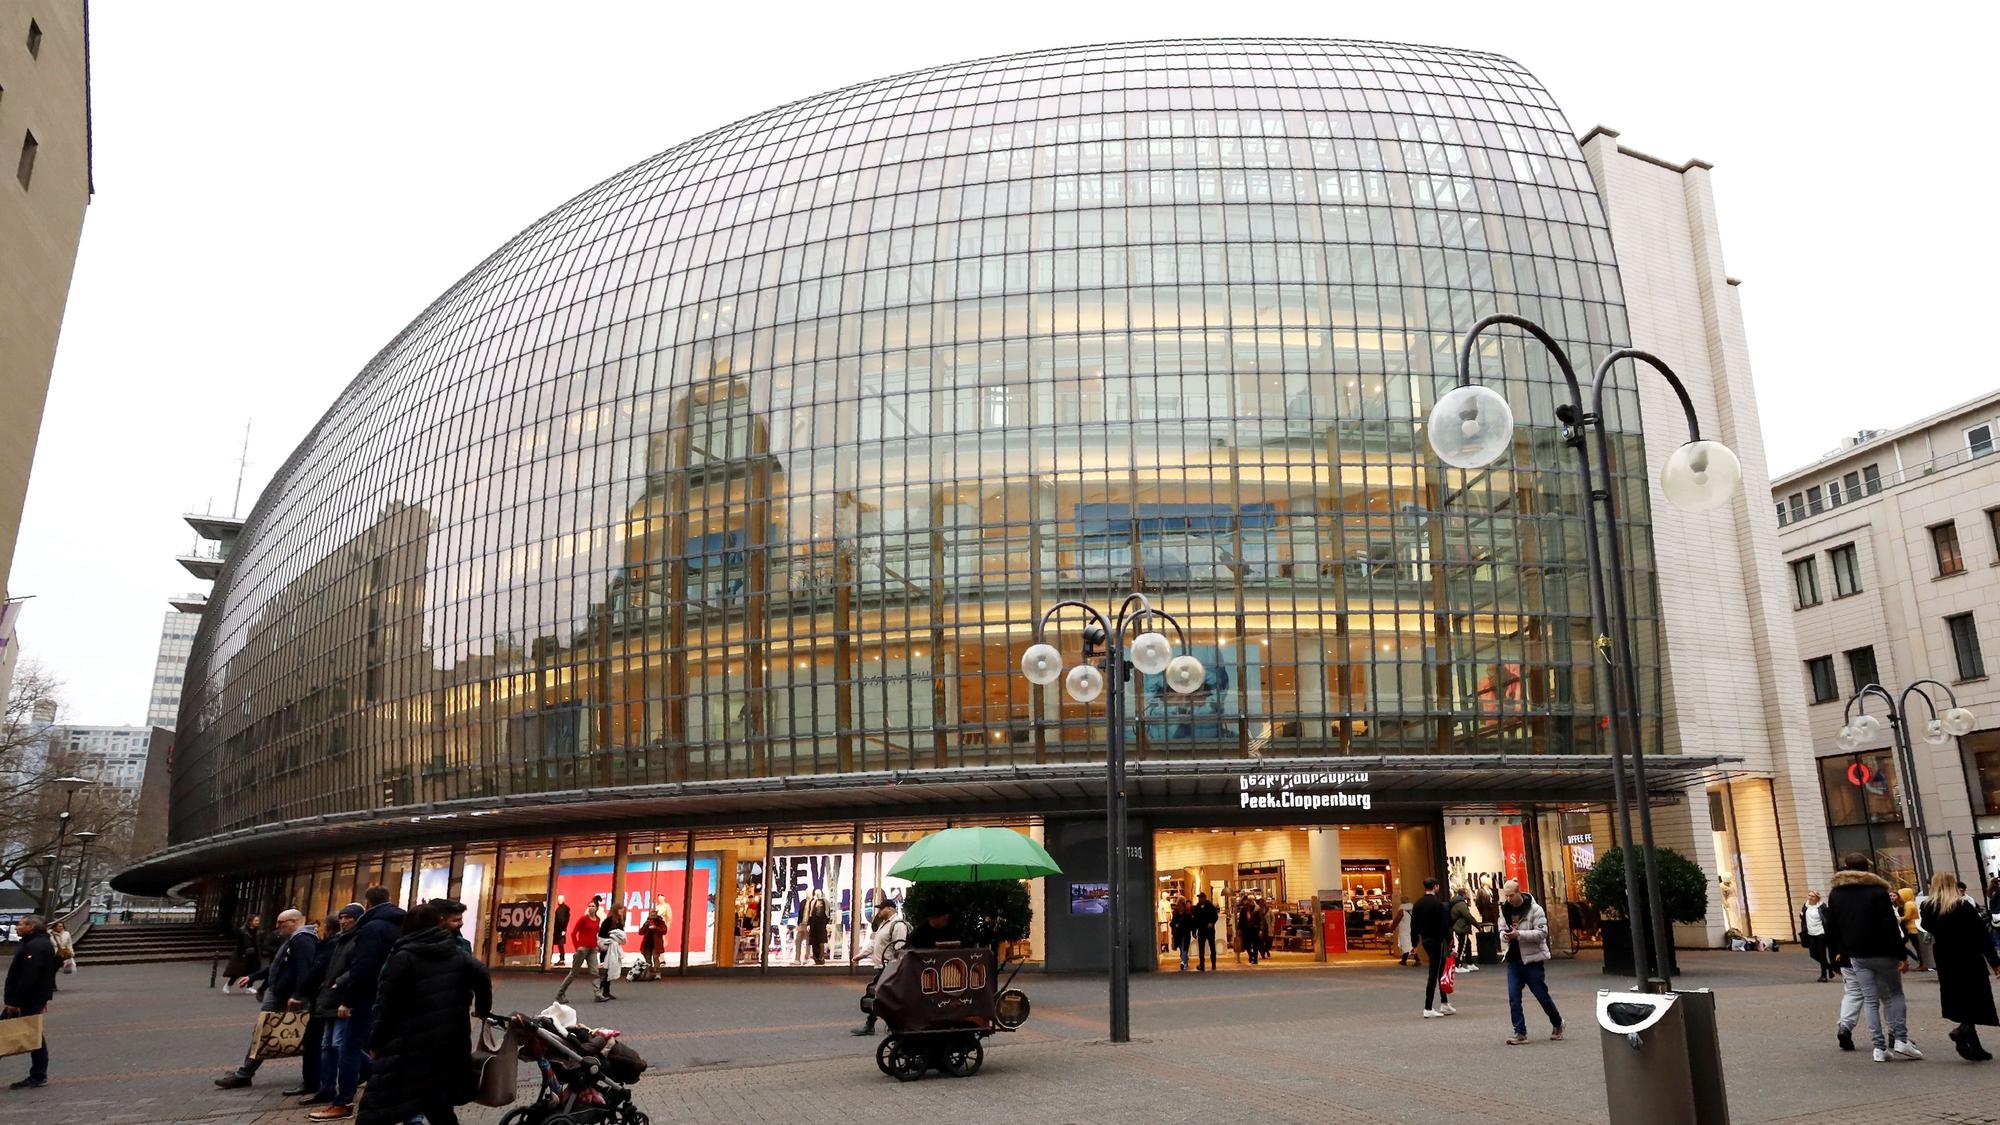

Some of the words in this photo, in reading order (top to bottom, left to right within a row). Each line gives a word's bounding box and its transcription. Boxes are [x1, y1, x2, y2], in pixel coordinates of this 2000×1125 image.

[1240, 792, 1371, 810] Peek&Cloppenburg
[772, 855, 842, 894] NEW
[595, 891, 656, 910] FIAL
[500, 906, 543, 927] 50%
